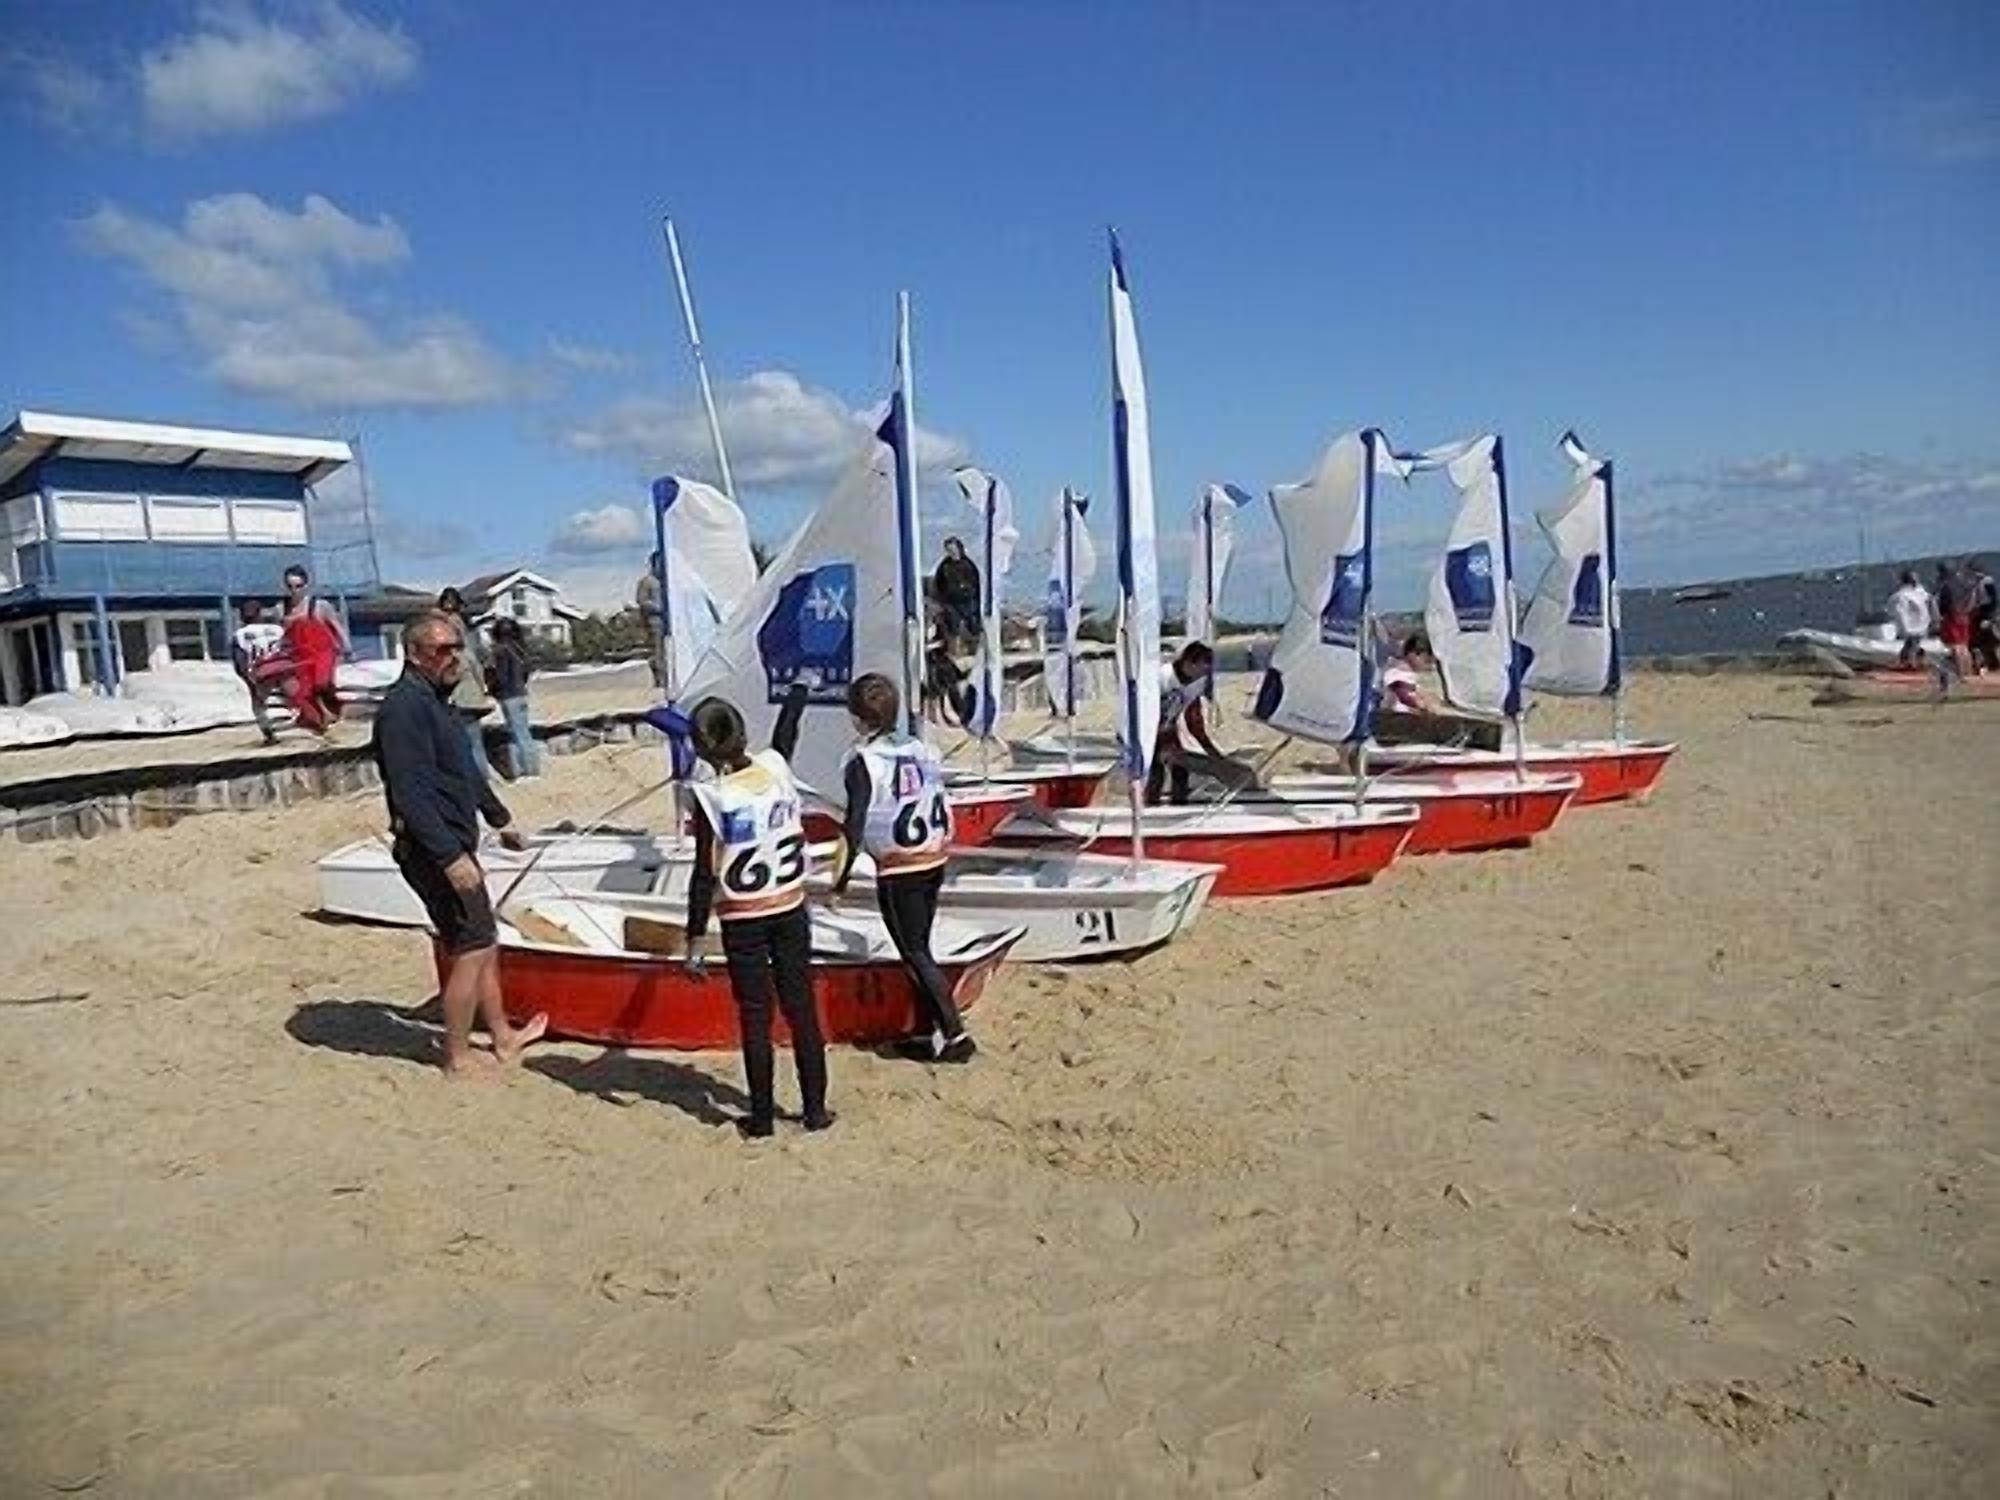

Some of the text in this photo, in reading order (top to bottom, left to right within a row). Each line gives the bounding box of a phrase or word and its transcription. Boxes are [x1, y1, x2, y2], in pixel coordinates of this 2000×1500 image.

[893, 792, 949, 847] 64
[725, 834, 804, 892] 63
[1075, 910, 1116, 942] 21
